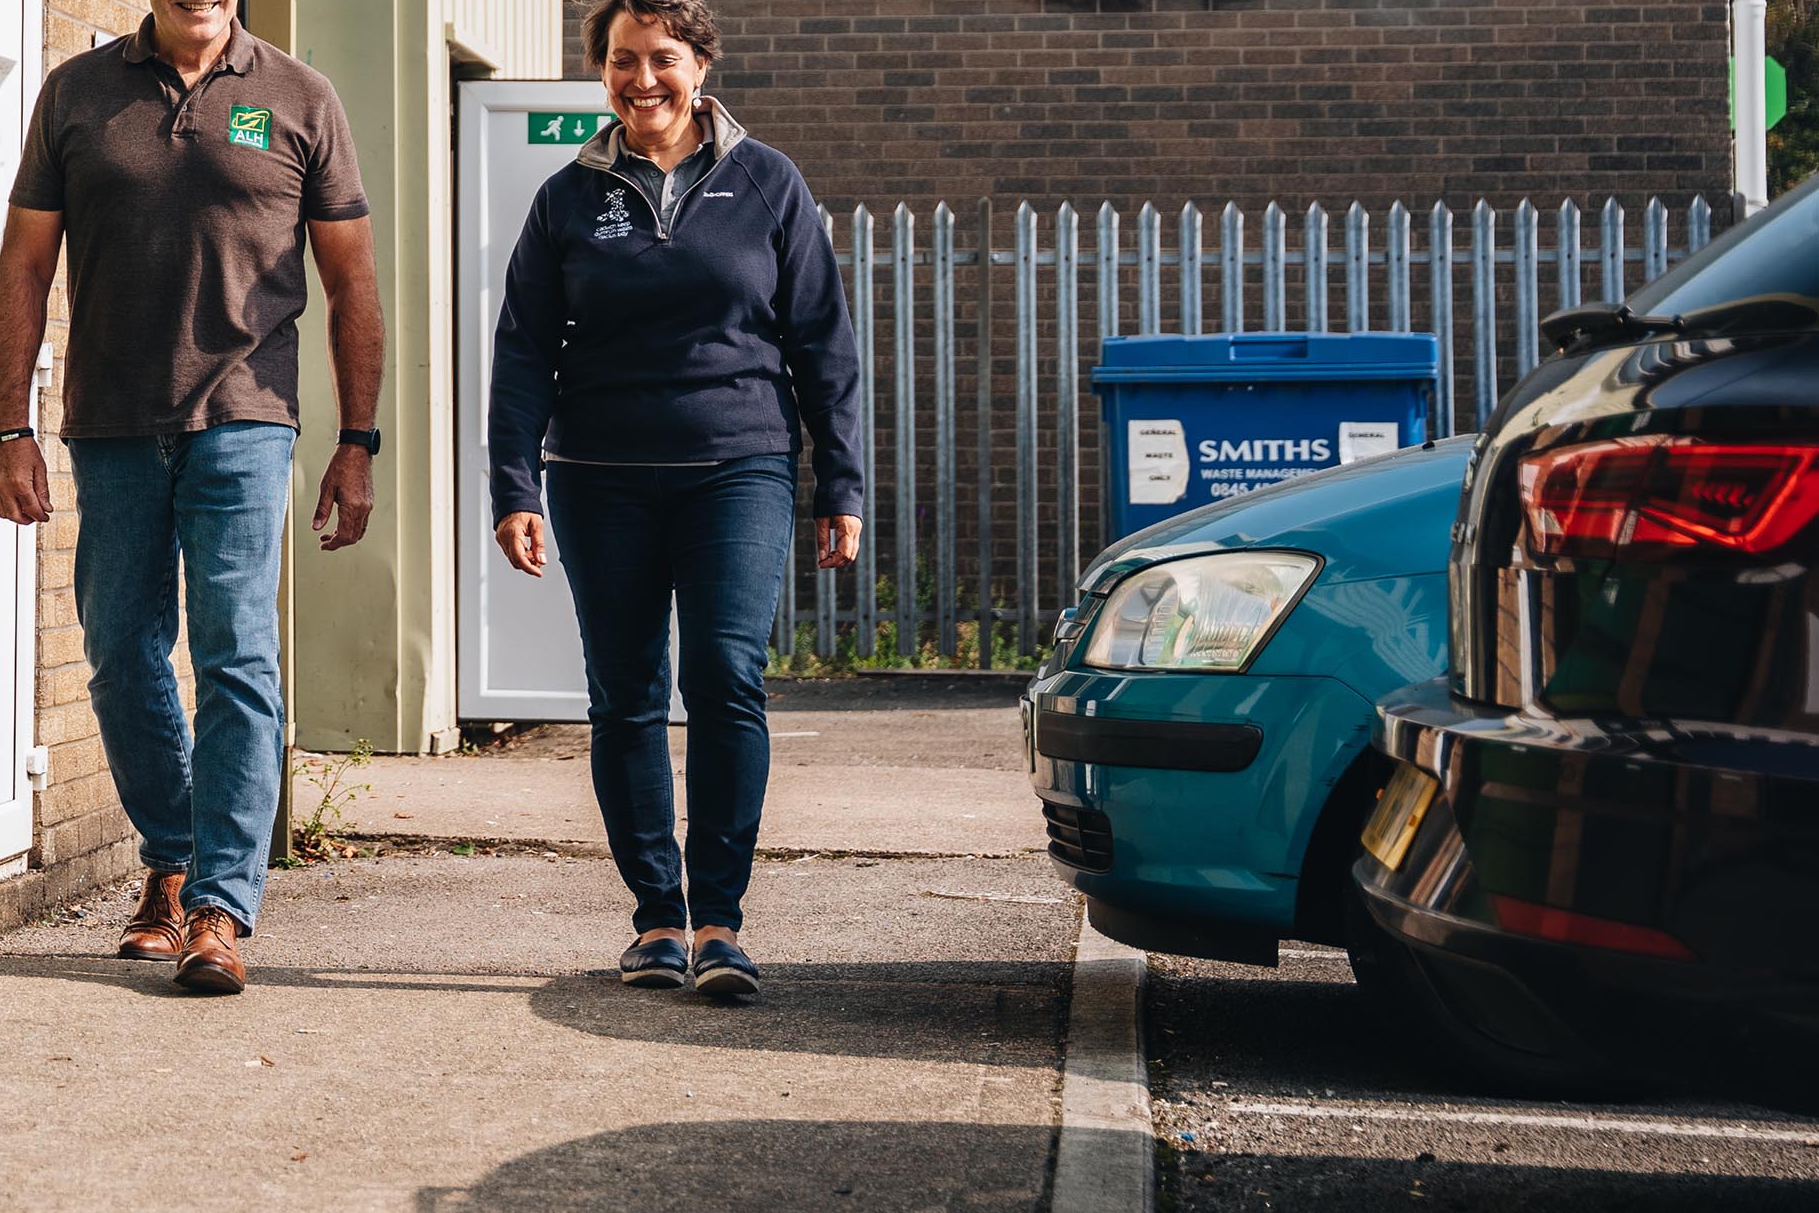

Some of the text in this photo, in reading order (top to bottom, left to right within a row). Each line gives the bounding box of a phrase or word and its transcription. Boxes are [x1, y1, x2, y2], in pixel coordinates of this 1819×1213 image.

[235, 129, 265, 145] ALH
[1199, 439, 1331, 462] SMITHS
[1201, 468, 1318, 480] WASTE MANAGEM
[1210, 482, 1249, 497] 0845
